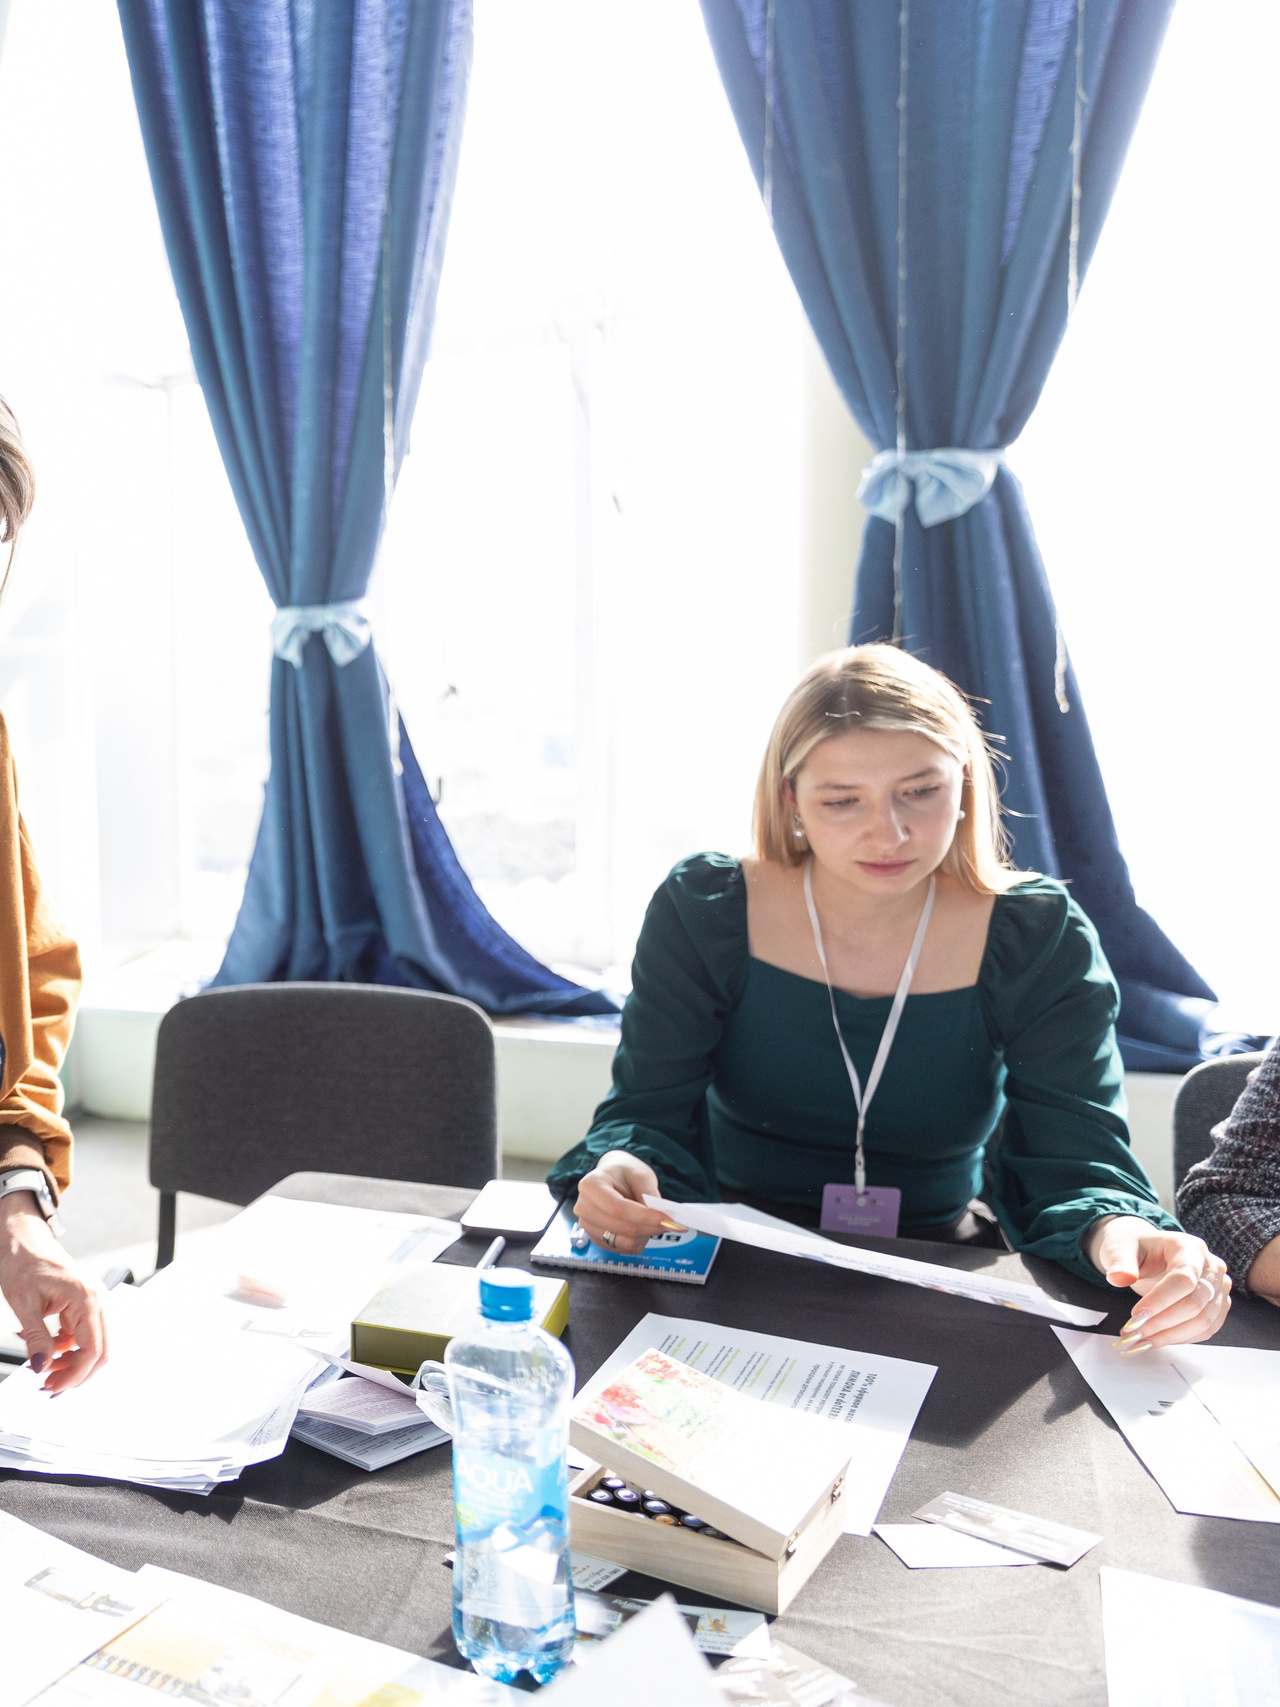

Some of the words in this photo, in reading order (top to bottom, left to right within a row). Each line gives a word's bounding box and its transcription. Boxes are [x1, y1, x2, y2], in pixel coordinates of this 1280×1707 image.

[841, 1370, 860, 1392] ЛИМОНА
[862, 1372, 877, 1387] 100%
[456, 1454, 534, 1494] AQUA
